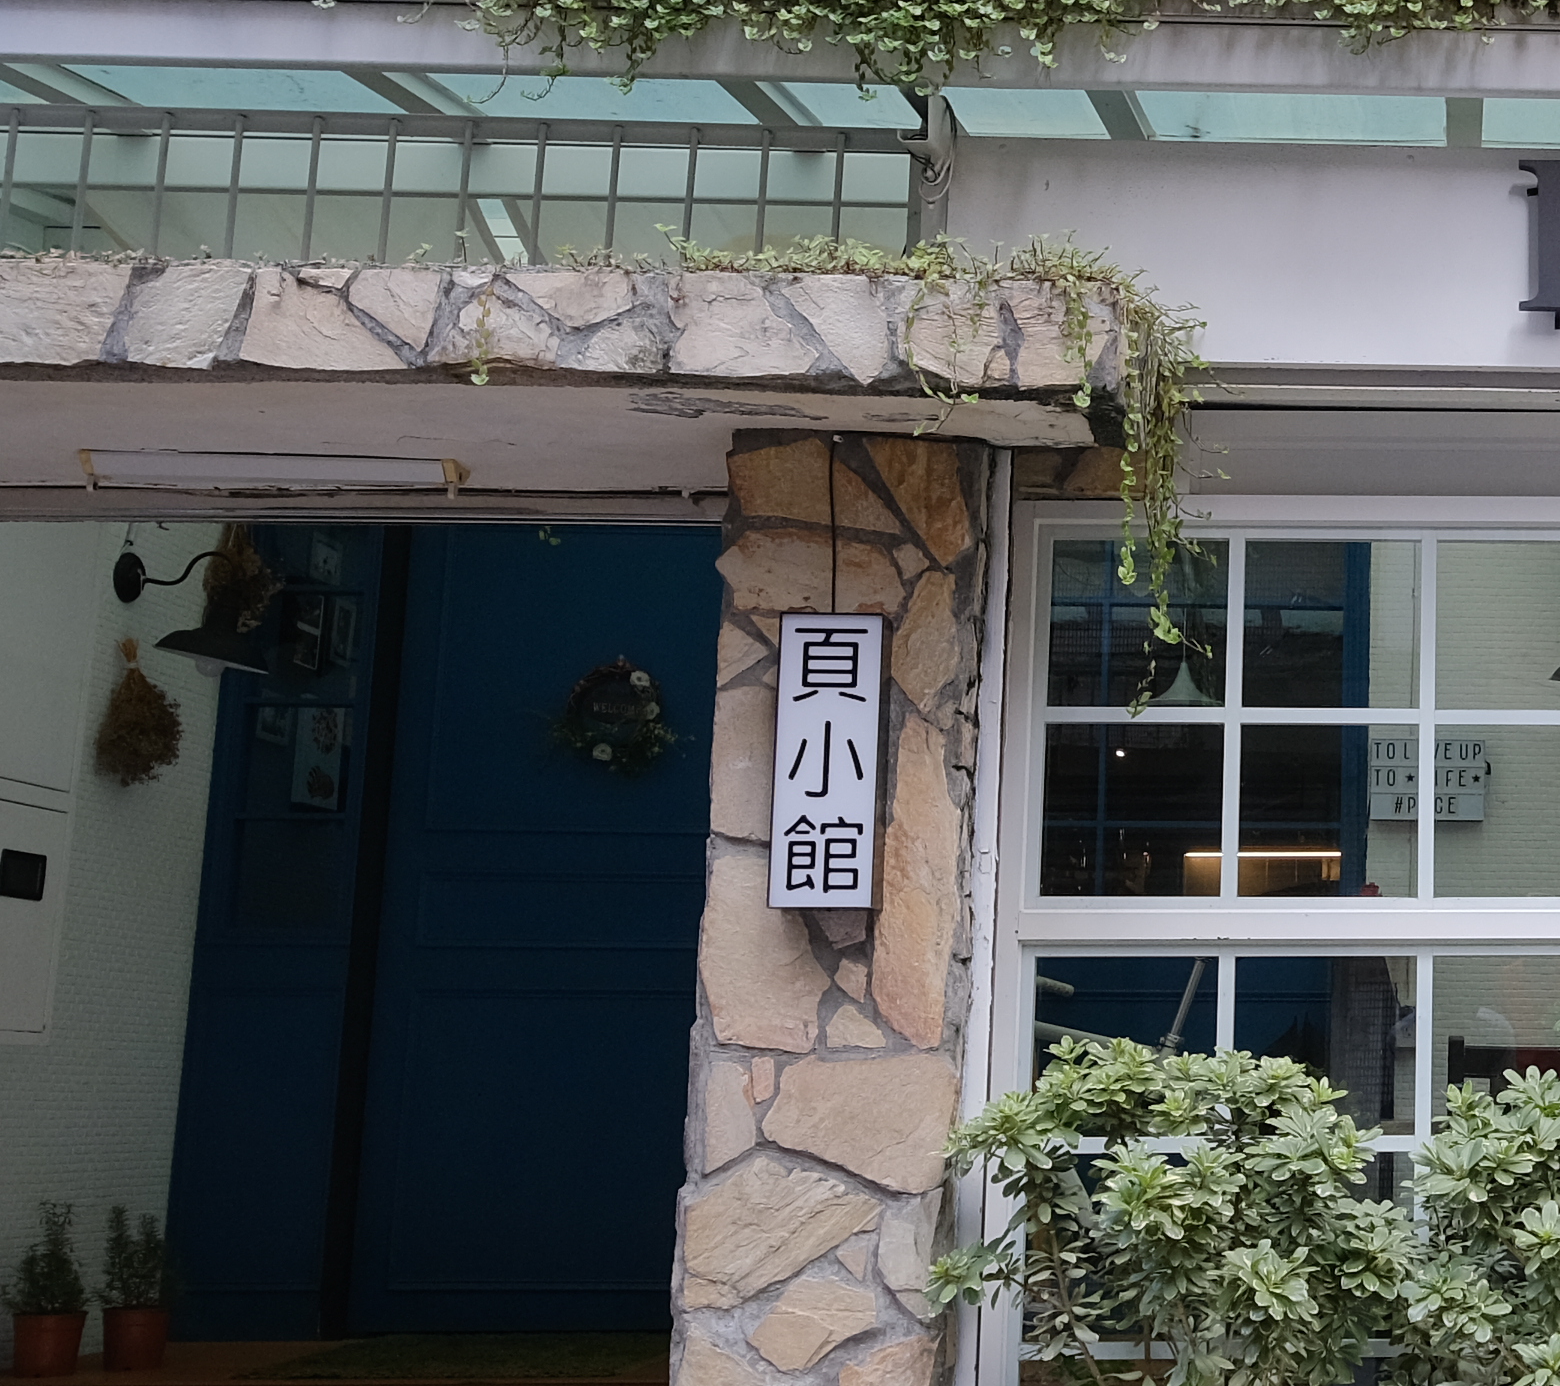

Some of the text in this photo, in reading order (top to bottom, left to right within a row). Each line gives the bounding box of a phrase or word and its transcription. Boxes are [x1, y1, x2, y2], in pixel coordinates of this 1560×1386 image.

[783, 627, 869, 894] 頁小館
[1374, 742, 1396, 760] TO
[1460, 743, 1482, 761] UP
[1374, 769, 1467, 787] TO IFE
[1395, 796, 1457, 814] #PGE
